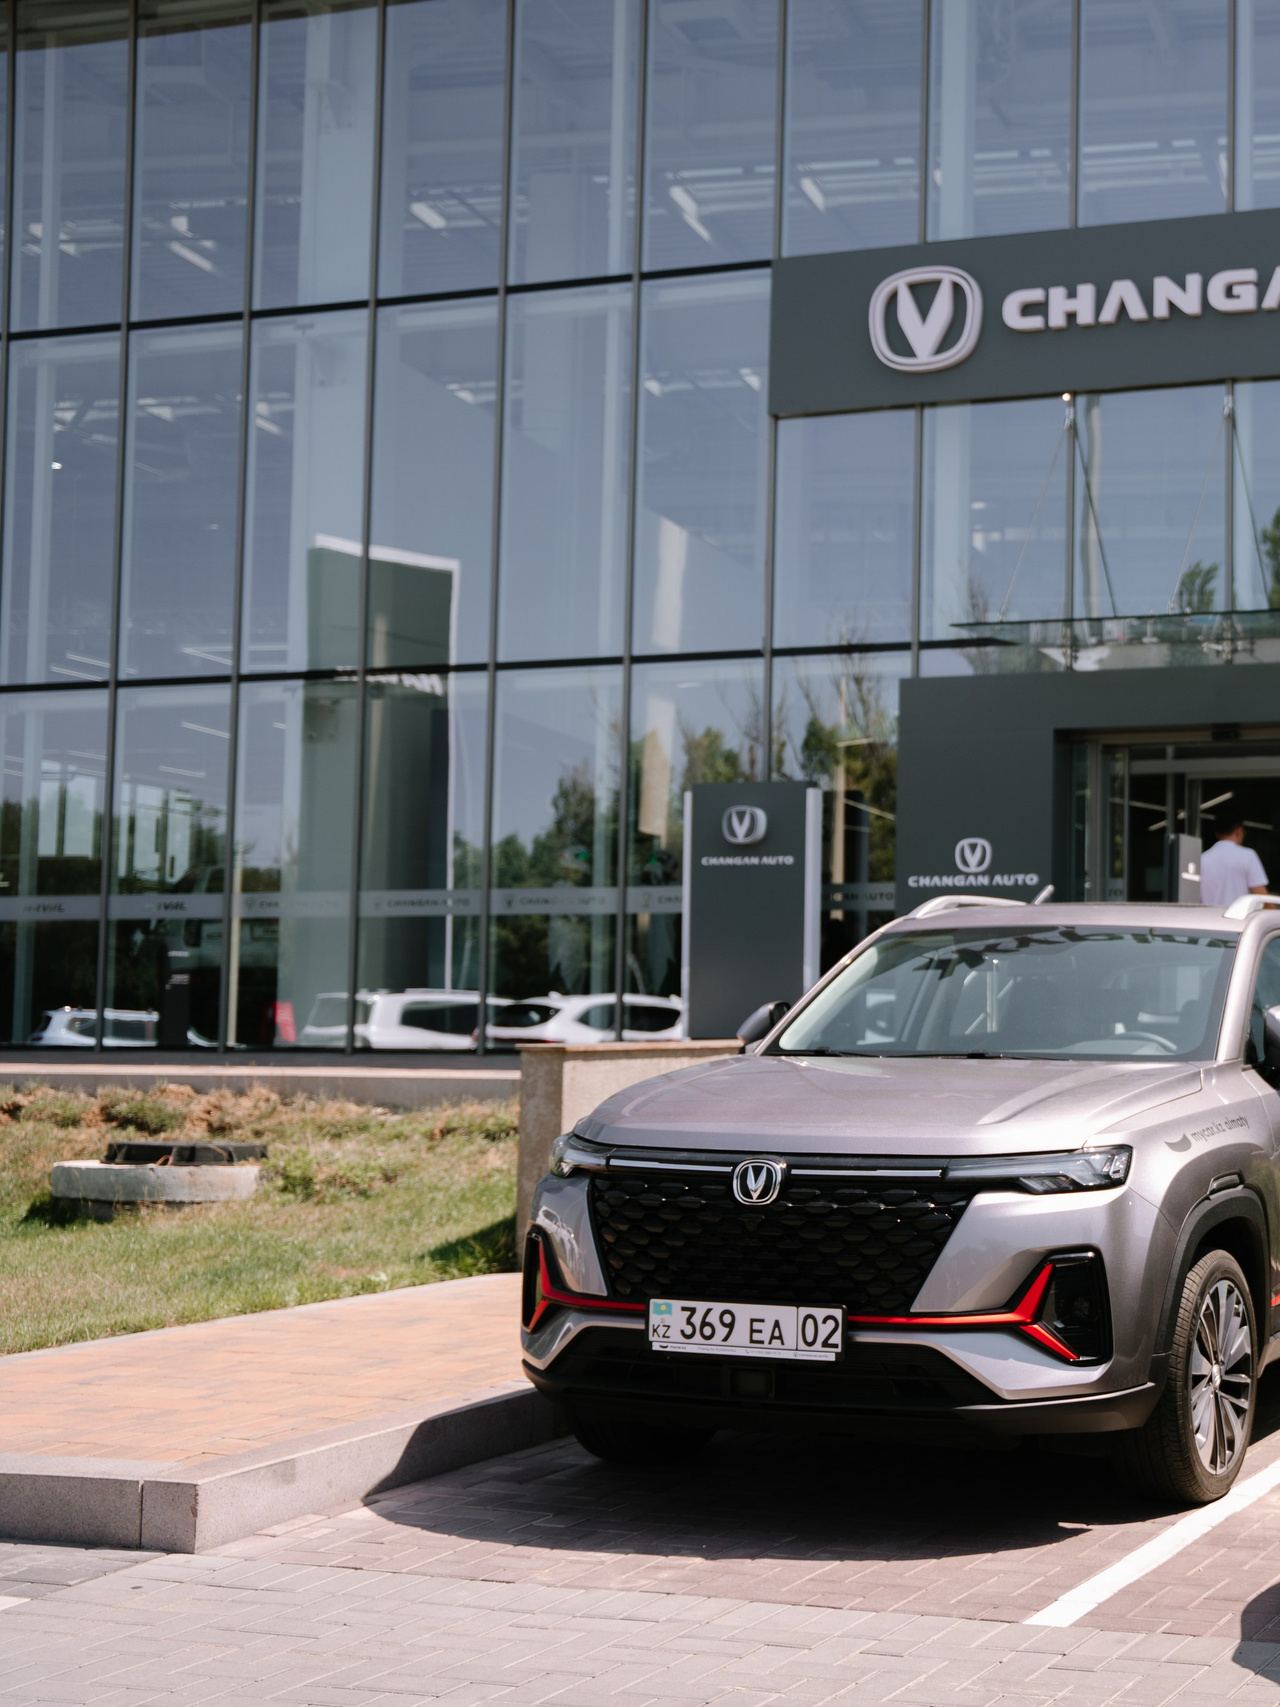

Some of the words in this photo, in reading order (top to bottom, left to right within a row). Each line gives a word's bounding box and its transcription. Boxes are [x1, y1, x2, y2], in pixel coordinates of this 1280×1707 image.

[701, 855, 758, 866] CHANGAN
[759, 854, 795, 866] AUTO
[908, 874, 989, 888] CHANGAN
[992, 873, 1039, 887] AUTO
[1190, 1122, 1225, 1144] mycar.kz
[1226, 1115, 1249, 1132] almaty
[652, 1324, 671, 1339] KZ
[680, 1306, 736, 1342] 369
[749, 1318, 785, 1346] EA
[801, 1313, 840, 1349] 02
